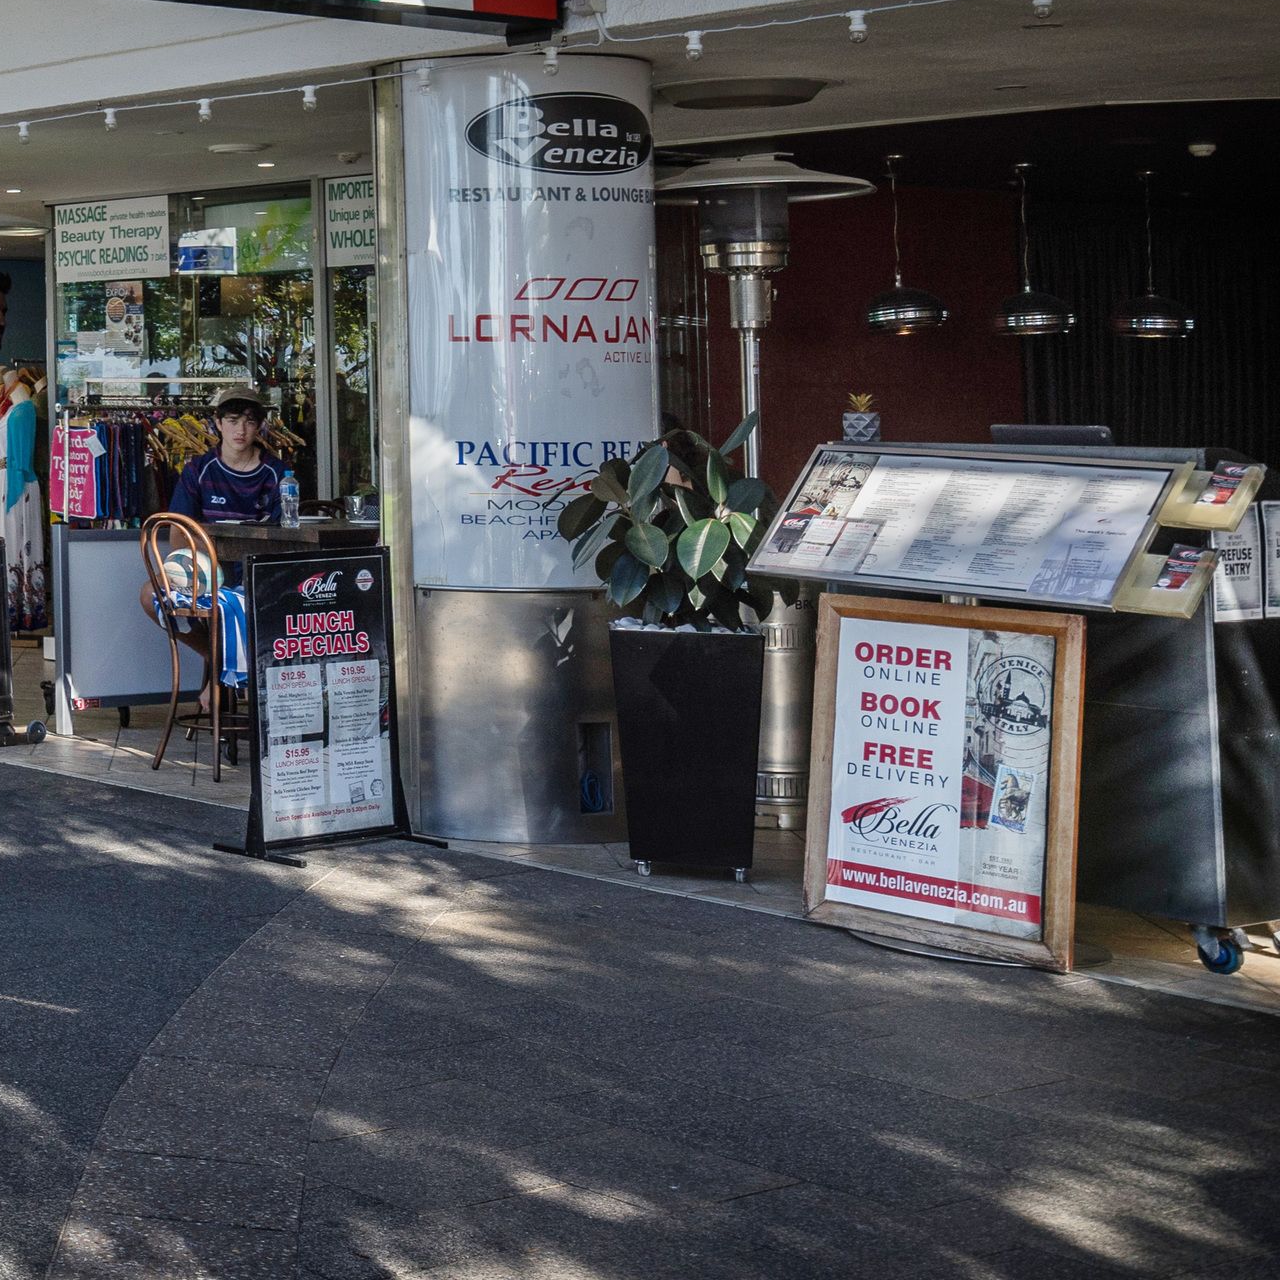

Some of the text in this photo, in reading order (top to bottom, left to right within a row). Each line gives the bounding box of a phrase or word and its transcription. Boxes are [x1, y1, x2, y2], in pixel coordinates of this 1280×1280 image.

[502, 104, 619, 140] Bella
[493, 136, 639, 168] Venezia
[449, 187, 644, 203] RESTAURANT & LOUNGE
[57, 205, 107, 225] MASSAGE
[329, 208, 359, 224] Unique
[61, 225, 162, 244] Beauty Therapy
[58, 245, 148, 267] PSYCHIC READINGS
[604, 352, 641, 363] ACTIVE
[455, 441, 593, 467] PACIFIC
[1222, 548, 1252, 560] REFUSE
[1225, 563, 1251, 576] ENTRY
[302, 571, 343, 599] Bella
[285, 610, 355, 636] LUNCH
[273, 631, 370, 660] SPECIALS
[854, 641, 953, 672] ORDER
[281, 671, 306, 681] $12.95
[341, 666, 366, 675] $19.95
[864, 665, 941, 686] ONLINE
[999, 659, 1045, 678] VENICE
[271, 679, 318, 690] LUNCH SPECIALS
[860, 691, 942, 720] BOOK
[861, 715, 939, 736] ONLINE
[275, 757, 319, 768] LUNCH SPECIALS
[286, 748, 310, 758] $15.95
[863, 741, 933, 770] FREE
[847, 763, 949, 788] DELIVERY
[849, 802, 957, 844] Bella
[882, 837, 938, 852] VENEZIA
[842, 866, 1027, 915] www.bellavenezia.com.au
